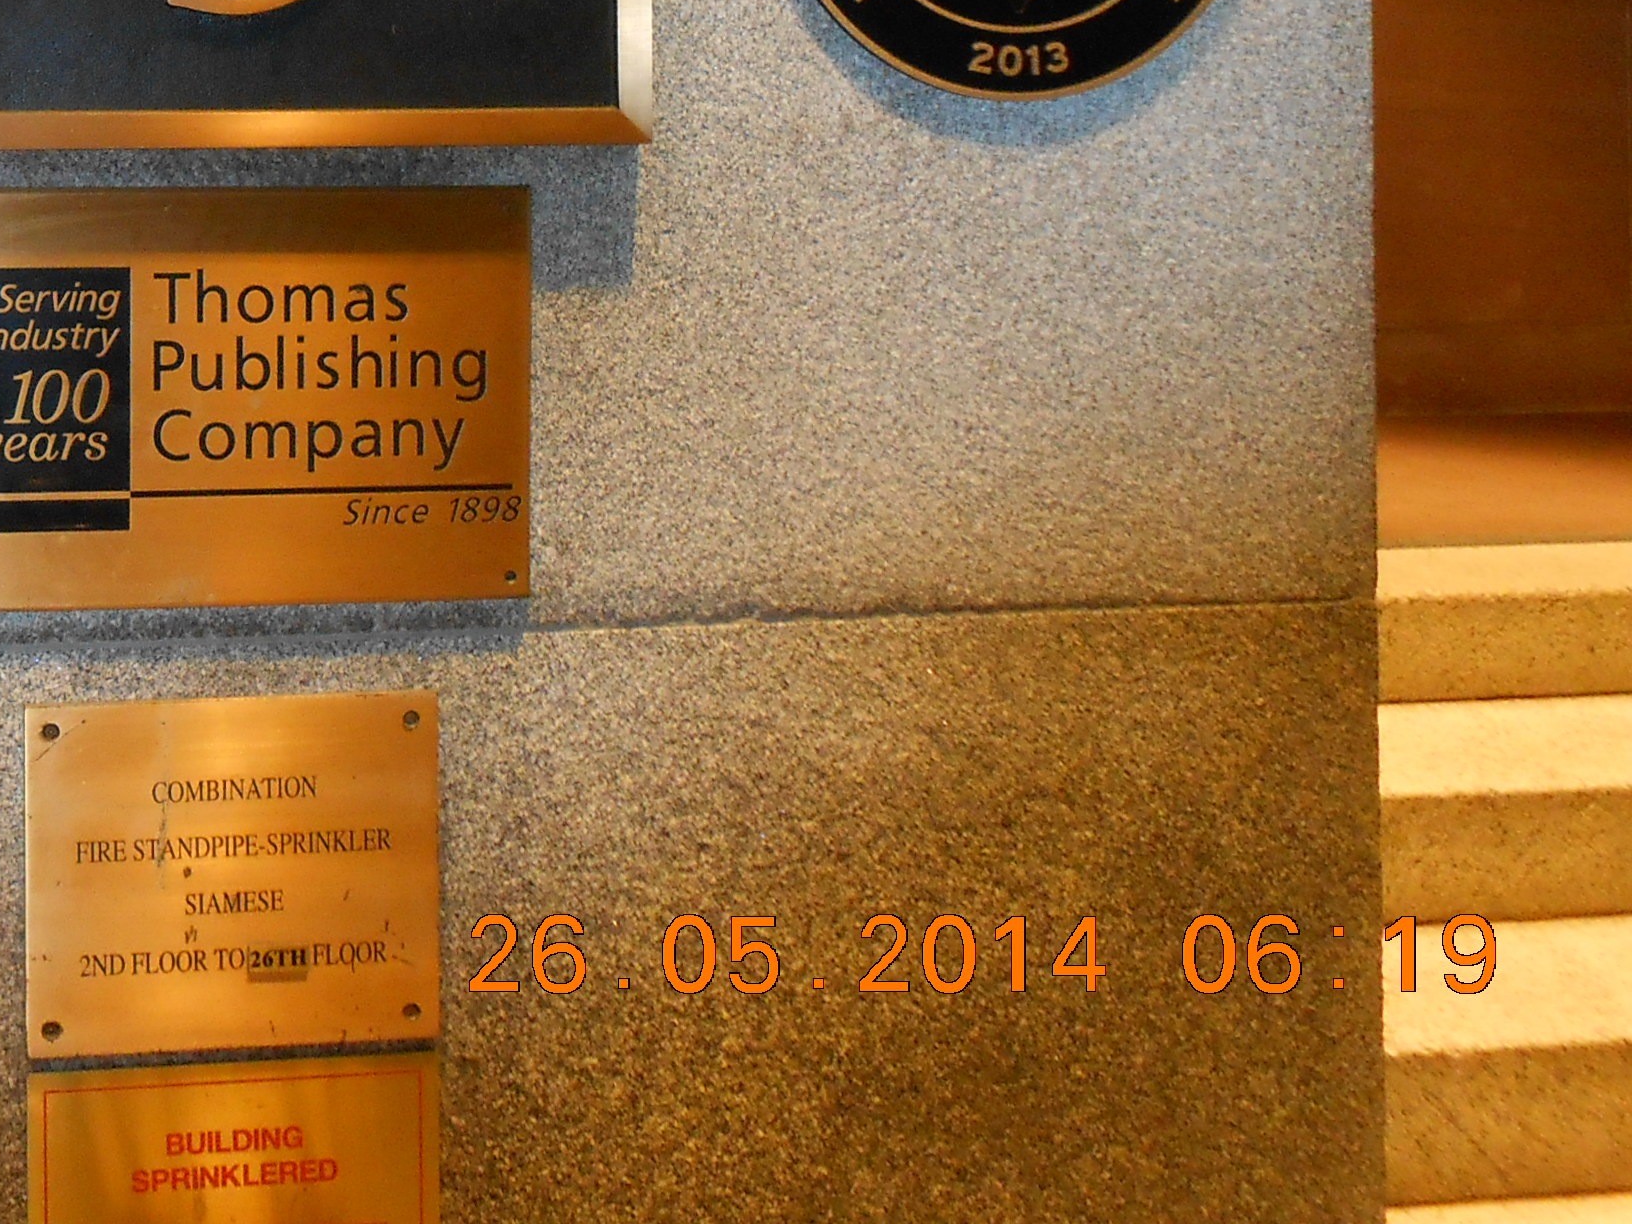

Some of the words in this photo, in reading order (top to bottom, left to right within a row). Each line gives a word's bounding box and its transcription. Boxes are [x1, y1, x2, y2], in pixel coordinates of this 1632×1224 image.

[969, 42, 1070, 77] 2013
[153, 269, 409, 324] Thomas
[153, 335, 488, 402] Publishing
[5, 368, 110, 425] 100
[153, 409, 465, 472] Company
[344, 497, 429, 527] Since
[449, 495, 522, 523] 1898
[152, 775, 317, 805] COMBINATION
[75, 840, 126, 864] FIRE
[132, 828, 392, 862] STANDPIPE-SPRINKLER
[185, 890, 284, 916] SIAMESE
[80, 954, 125, 978] 2ND
[132, 950, 206, 975] FLOOR
[214, 947, 244, 971] TO
[250, 949, 307, 969] 26TH
[312, 941, 386, 966] FLOOR
[165, 1125, 304, 1156] BUILDING
[131, 1158, 338, 1193] SPRINKLERED
